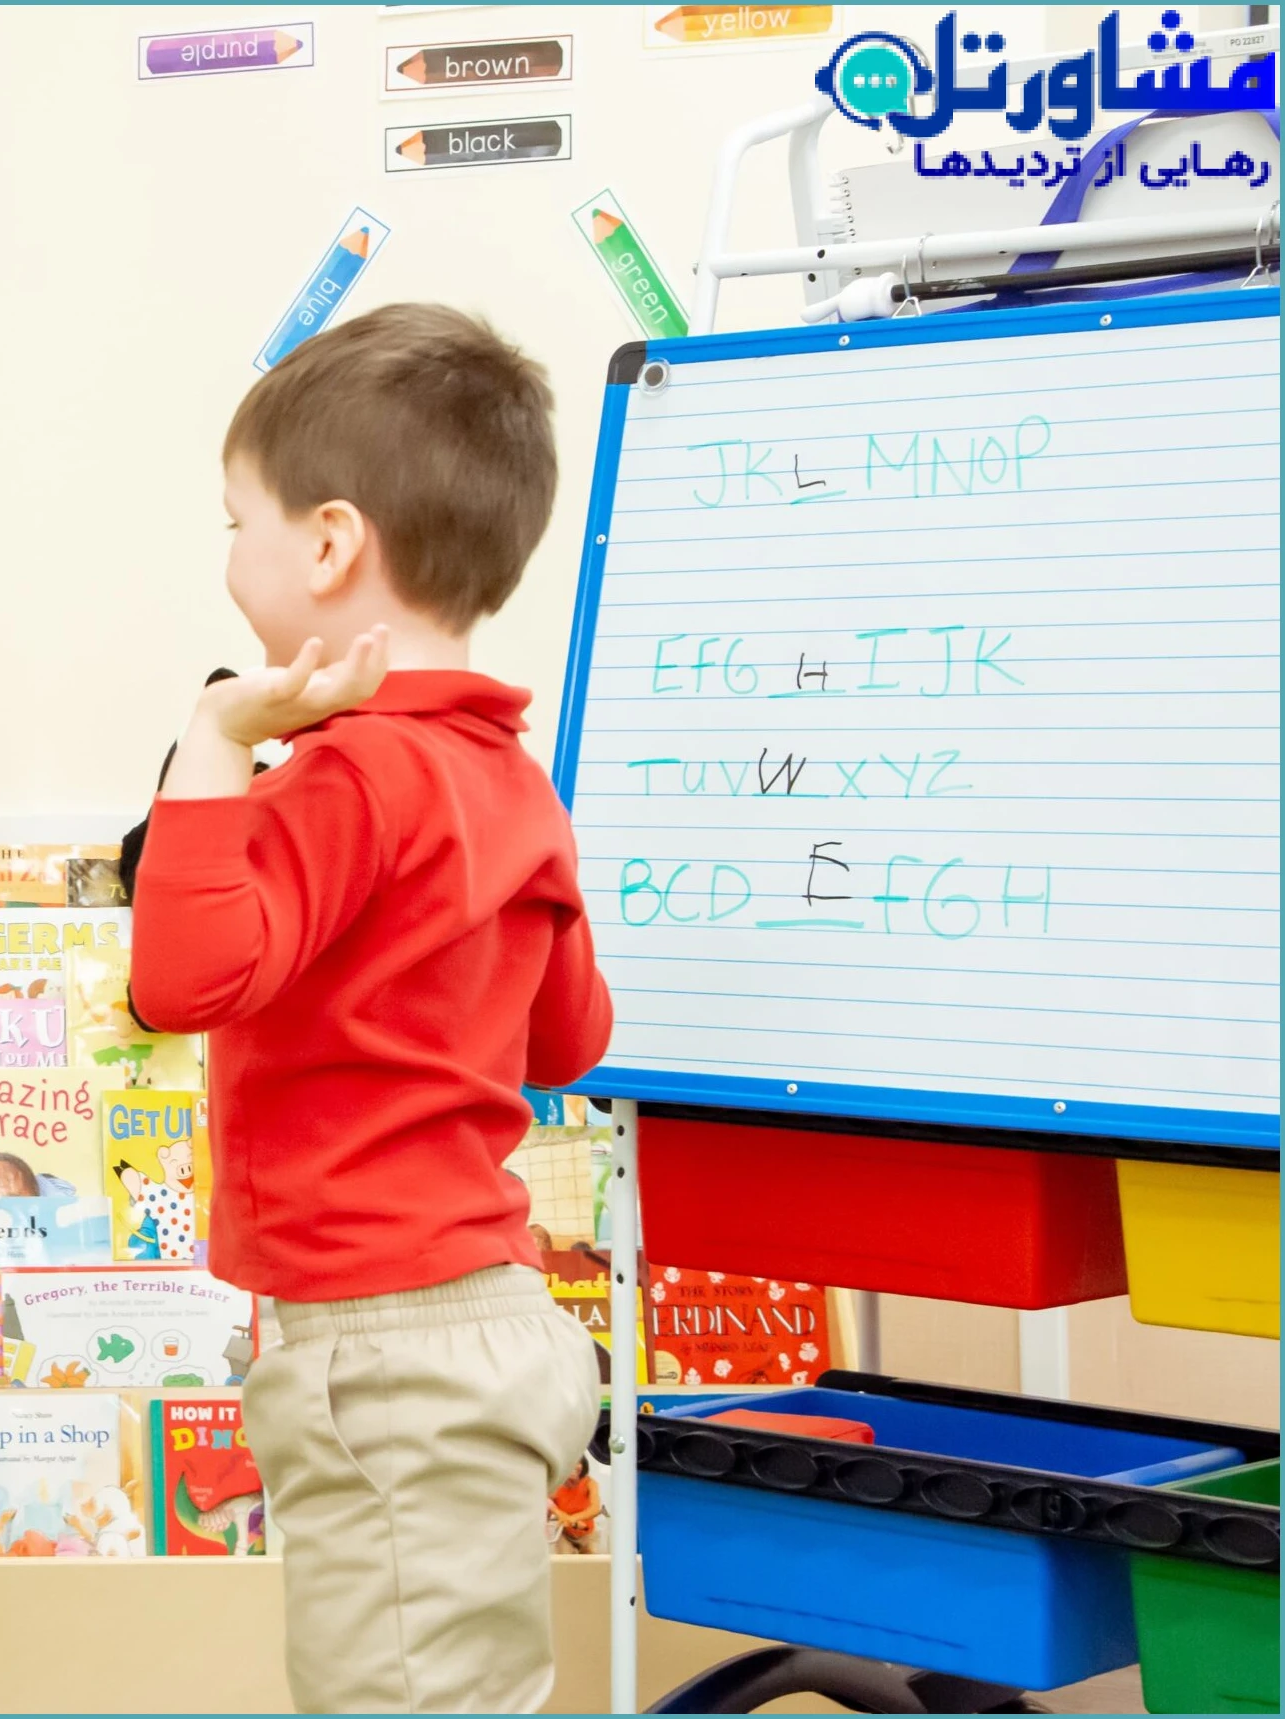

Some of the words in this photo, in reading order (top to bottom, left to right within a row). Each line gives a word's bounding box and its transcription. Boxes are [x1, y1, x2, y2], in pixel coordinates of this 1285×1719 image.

[700, 5, 791, 38] yellow
[181, 39, 259, 64] purple
[444, 55, 530, 79] brown
[448, 129, 516, 156] black
[297, 276, 342, 327] blue
[615, 251, 668, 325] green
[32, 1006, 66, 1049] U
[109, 1104, 160, 1140] GET
[93, 1281, 118, 1293] the
[123, 1279, 184, 1294] Terrible
[189, 1284, 231, 1304] Eater
[679, 1286, 705, 1297] THE
[714, 1285, 753, 1296] STORY
[652, 1304, 815, 1336] ERDINAND
[170, 1406, 213, 1422] HOW
[218, 1407, 237, 1421] IT
[18, 1425, 37, 1444] in
[43, 1430, 55, 1444] a
[60, 1424, 110, 1448] Shop
